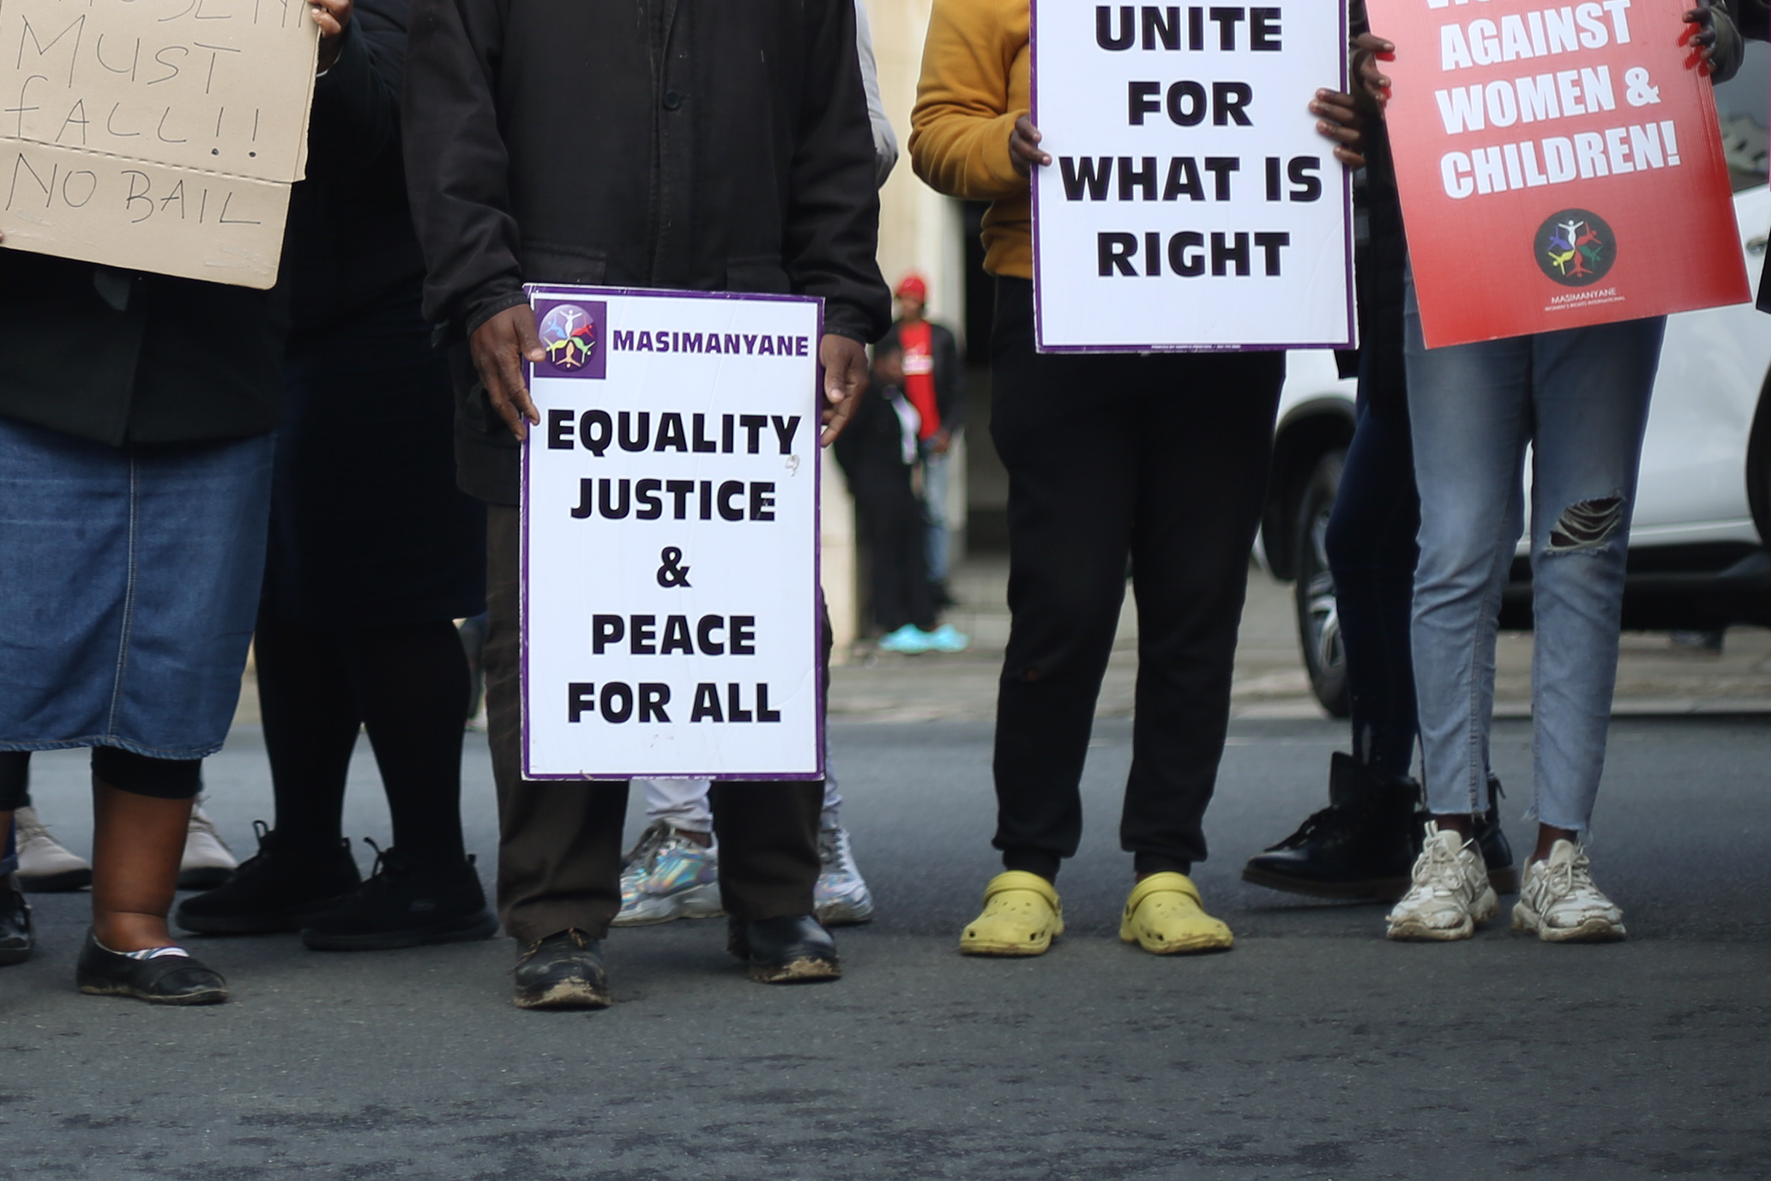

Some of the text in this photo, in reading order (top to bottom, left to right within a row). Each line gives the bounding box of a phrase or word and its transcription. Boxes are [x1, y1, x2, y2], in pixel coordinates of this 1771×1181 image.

[1095, 6, 1282, 51] UNITE
[17, 14, 241, 94] MUST
[1128, 81, 1253, 126] FOR
[1435, 65, 1660, 135] WOMEN &
[1059, 156, 1322, 202] WHAT IS
[1439, 120, 1681, 200] CHILDREN!
[5, 153, 261, 224] NO BAIL
[1097, 231, 1290, 278] RIGHT
[613, 330, 809, 356] MASIMANYANE
[547, 409, 801, 457] EQUALITY
[570, 478, 776, 521] JUSTICE
[656, 546, 691, 588] &
[592, 614, 756, 655] PEACE
[567, 682, 781, 723] FOR ALL
